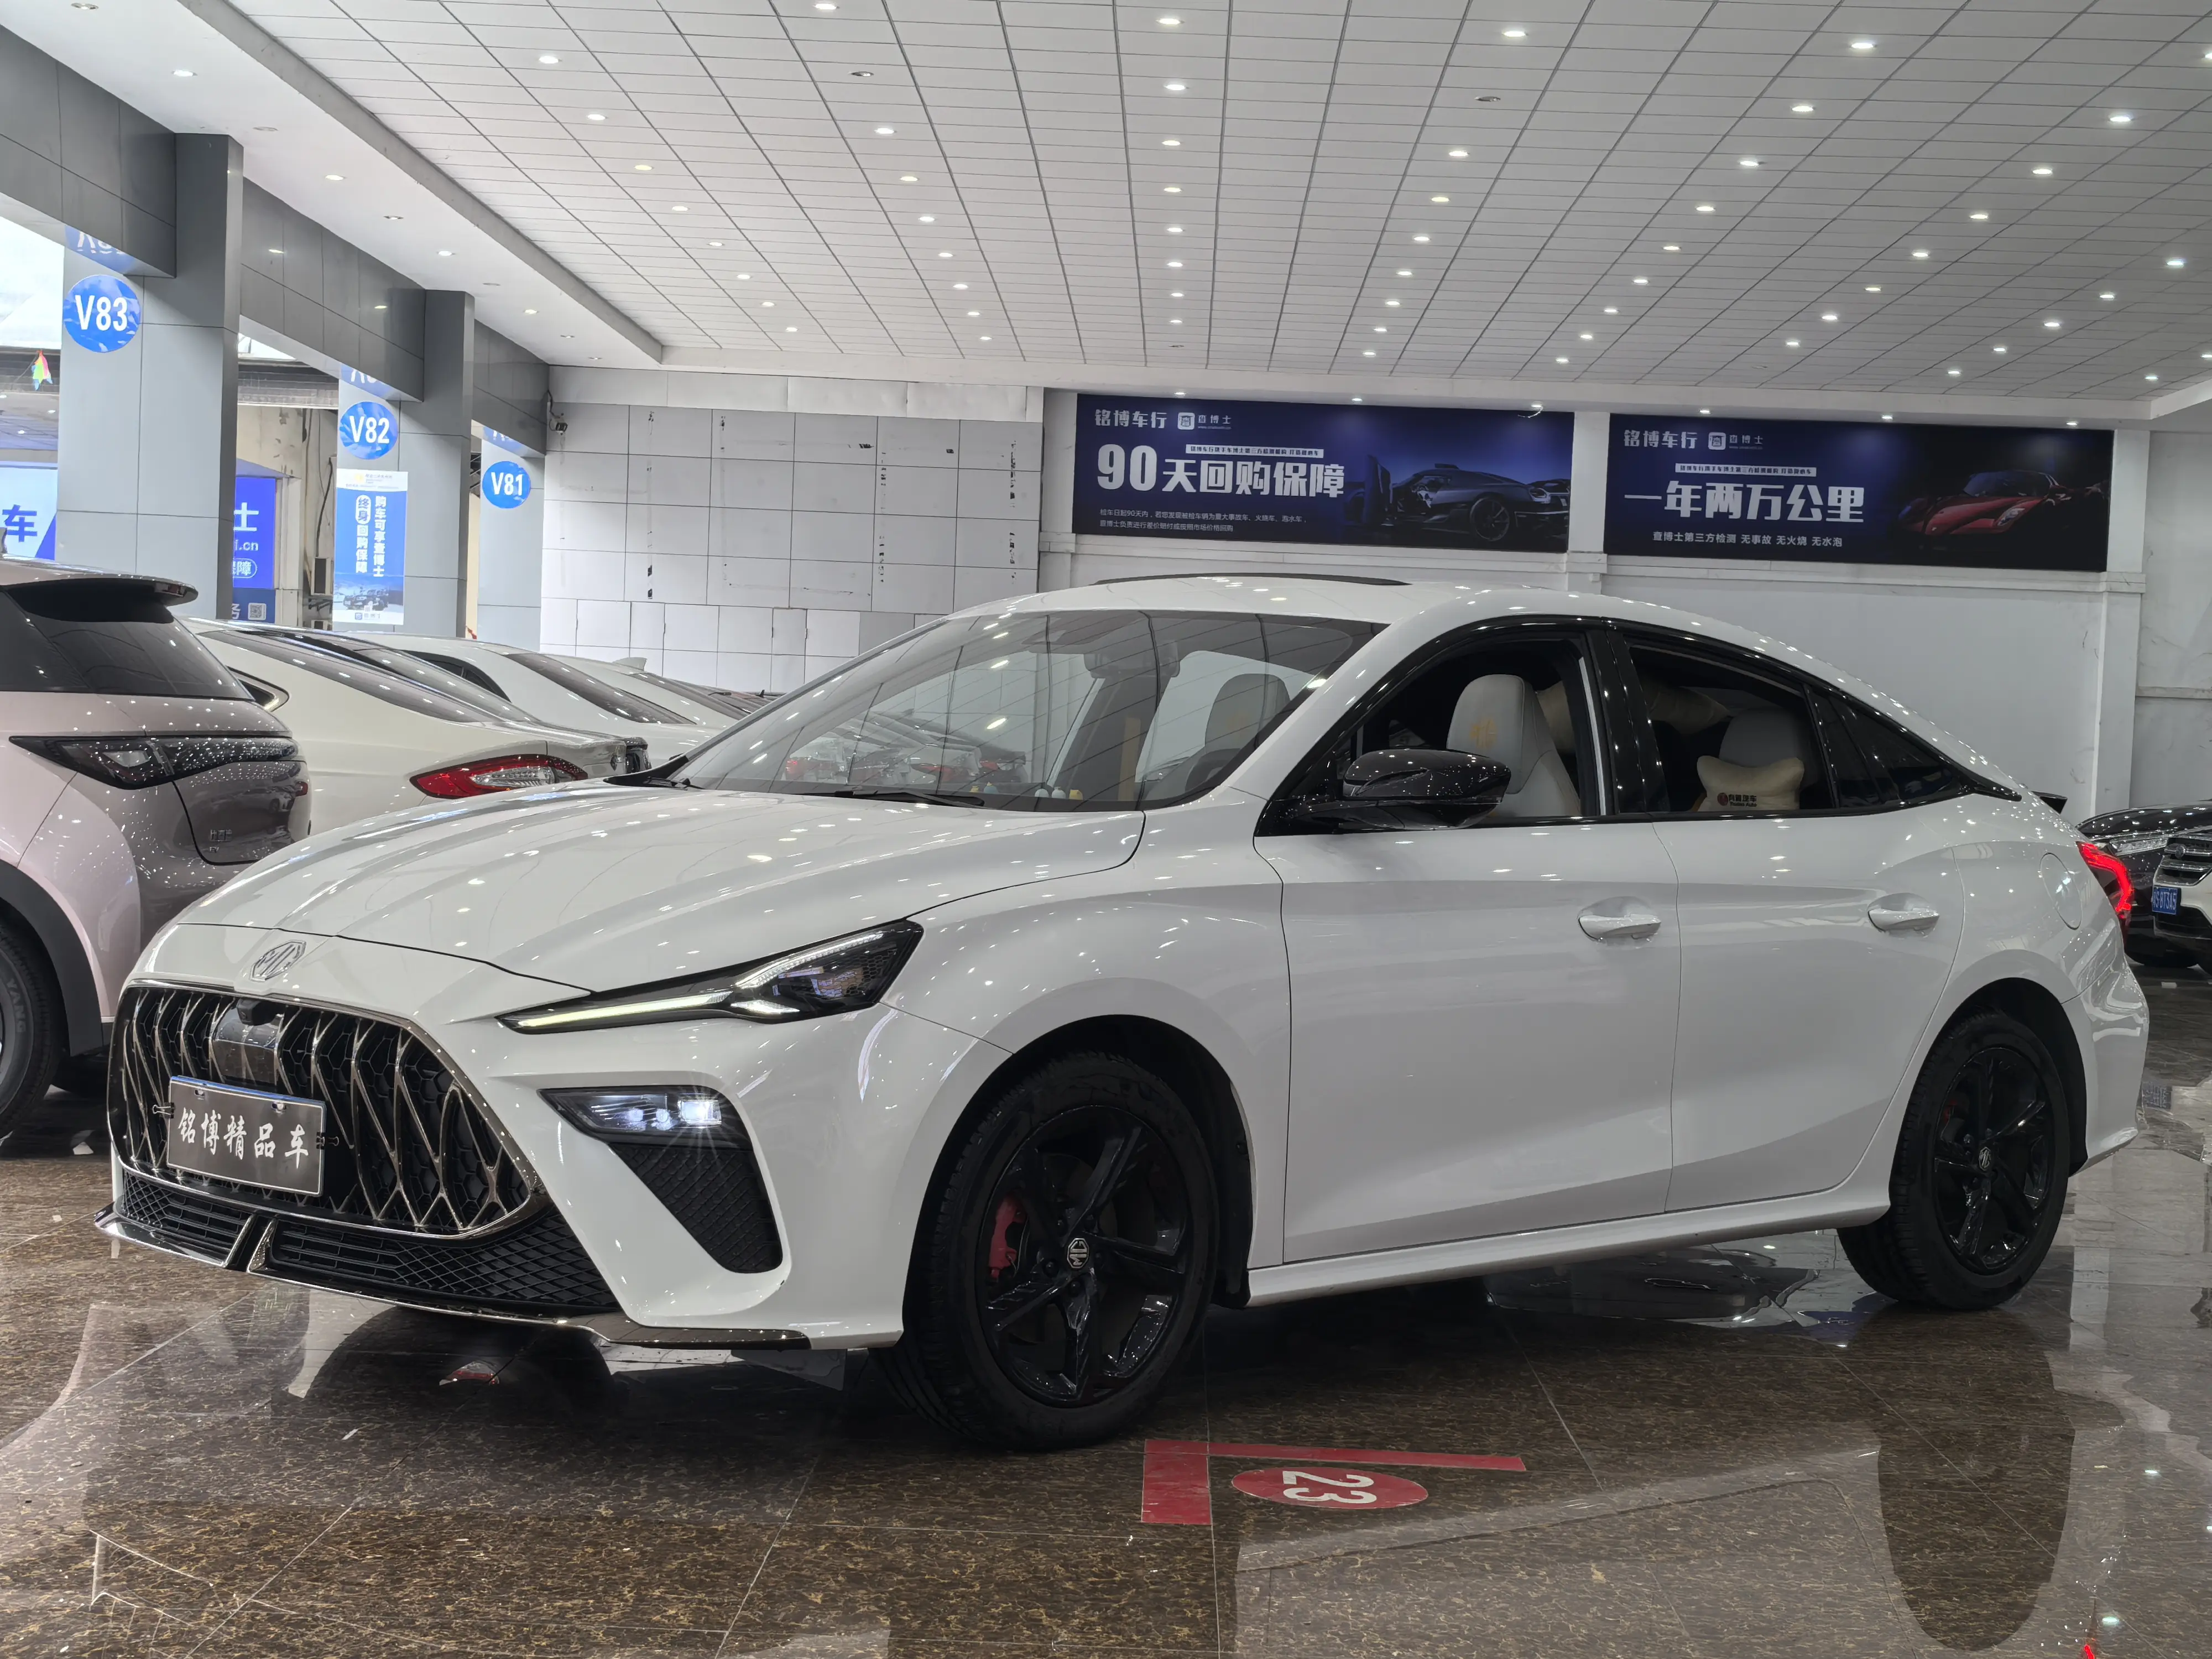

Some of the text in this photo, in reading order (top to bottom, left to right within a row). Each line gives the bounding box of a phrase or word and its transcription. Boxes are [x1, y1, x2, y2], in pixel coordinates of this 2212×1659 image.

[75, 295, 128, 331] V83
[349, 415, 390, 444] V82
[1095, 409, 1167, 429] 铭博车行
[1624, 429, 1698, 449] 铭博车行
[491, 472, 523, 496] V81
[1097, 444, 1345, 498] 90天回购保障
[1624, 481, 1865, 523] 一年两万公里
[2, 504, 38, 542] 车
[1652, 531, 1843, 547] 查博士第三方检测 无事故 无火烧 无水泡
[178, 1107, 309, 1169] 铭博精品车
[1282, 1470, 1378, 1504] 23
